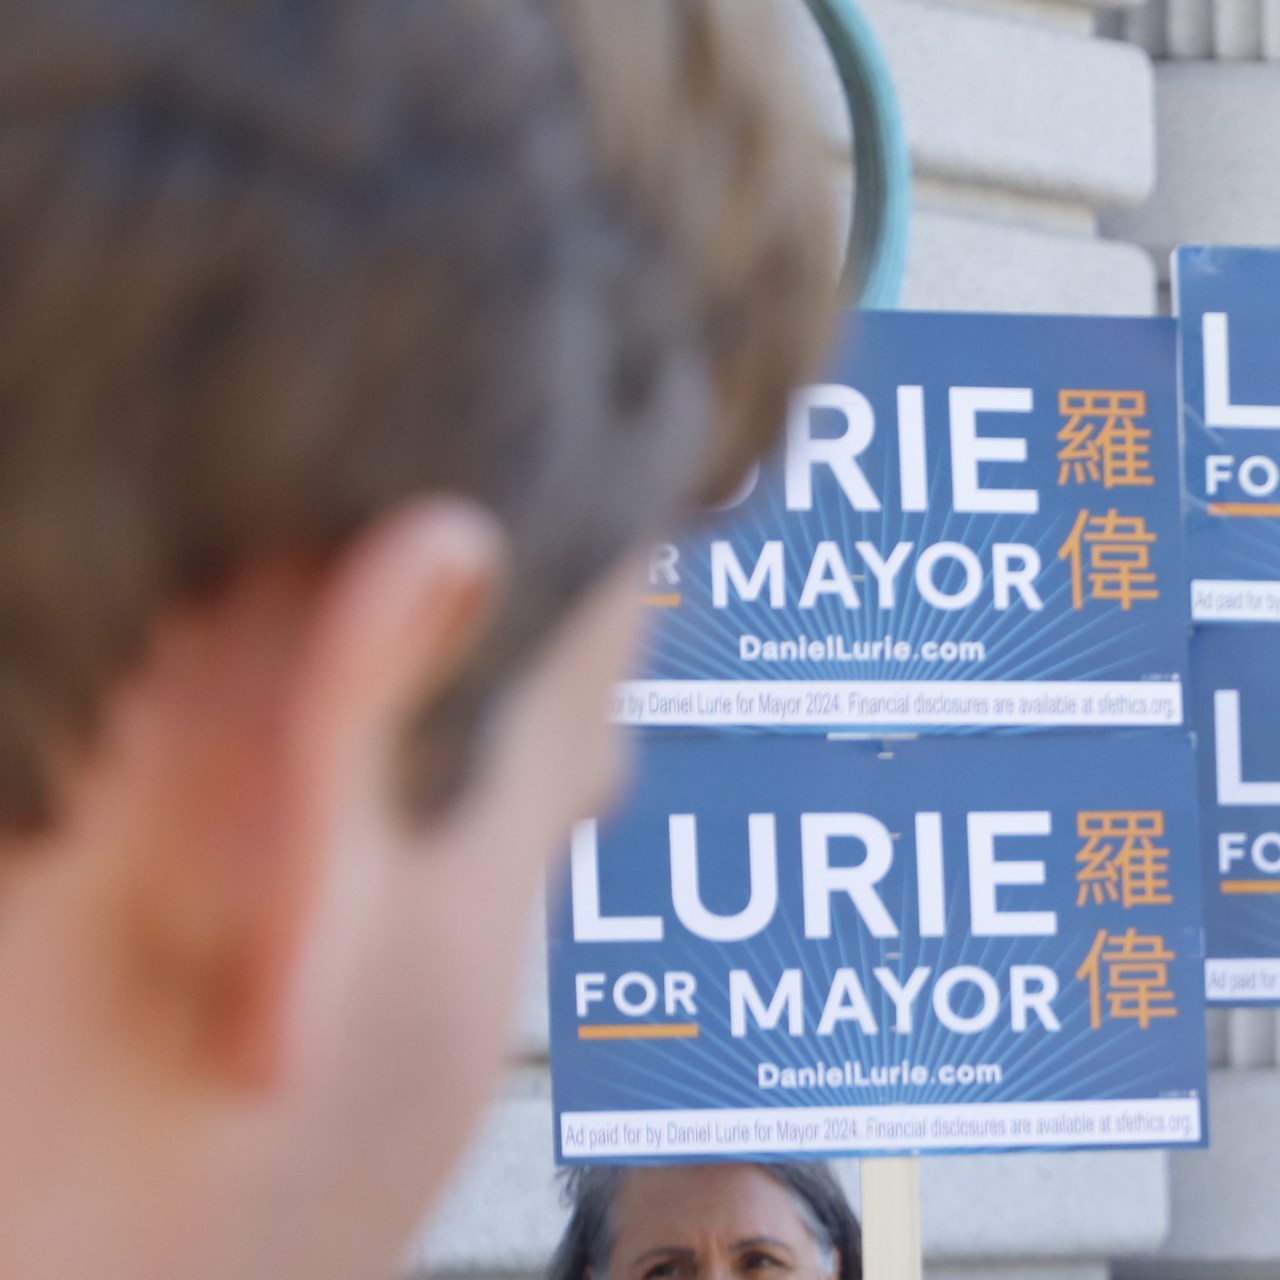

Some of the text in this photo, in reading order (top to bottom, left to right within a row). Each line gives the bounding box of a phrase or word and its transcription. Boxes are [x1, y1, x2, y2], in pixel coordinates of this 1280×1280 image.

[706, 384, 1040, 514] RIE
[711, 541, 1043, 610] MAYOR
[738, 633, 987, 663] DanielLurie.com
[570, 811, 1057, 942] LURIE
[576, 965, 1060, 1037] FOR MAYOR
[756, 1058, 1004, 1090] DanielLurie.com
[564, 1124, 584, 1144] Ad
[588, 1123, 618, 1150] paid
[623, 1122, 642, 1143] for
[645, 1122, 661, 1148] by
[666, 1121, 710, 1142] Daniel
[714, 1120, 749, 1141] Lurie
[753, 1120, 771, 1140] for
[776, 1119, 819, 1145] Mayor
[865, 1116, 926, 1137] Financial
[930, 1115, 1005, 1136] disclosures
[1010, 1119, 1031, 1134] are
[1035, 1113, 1093, 1133] available
[1097, 1112, 1110, 1131] at
